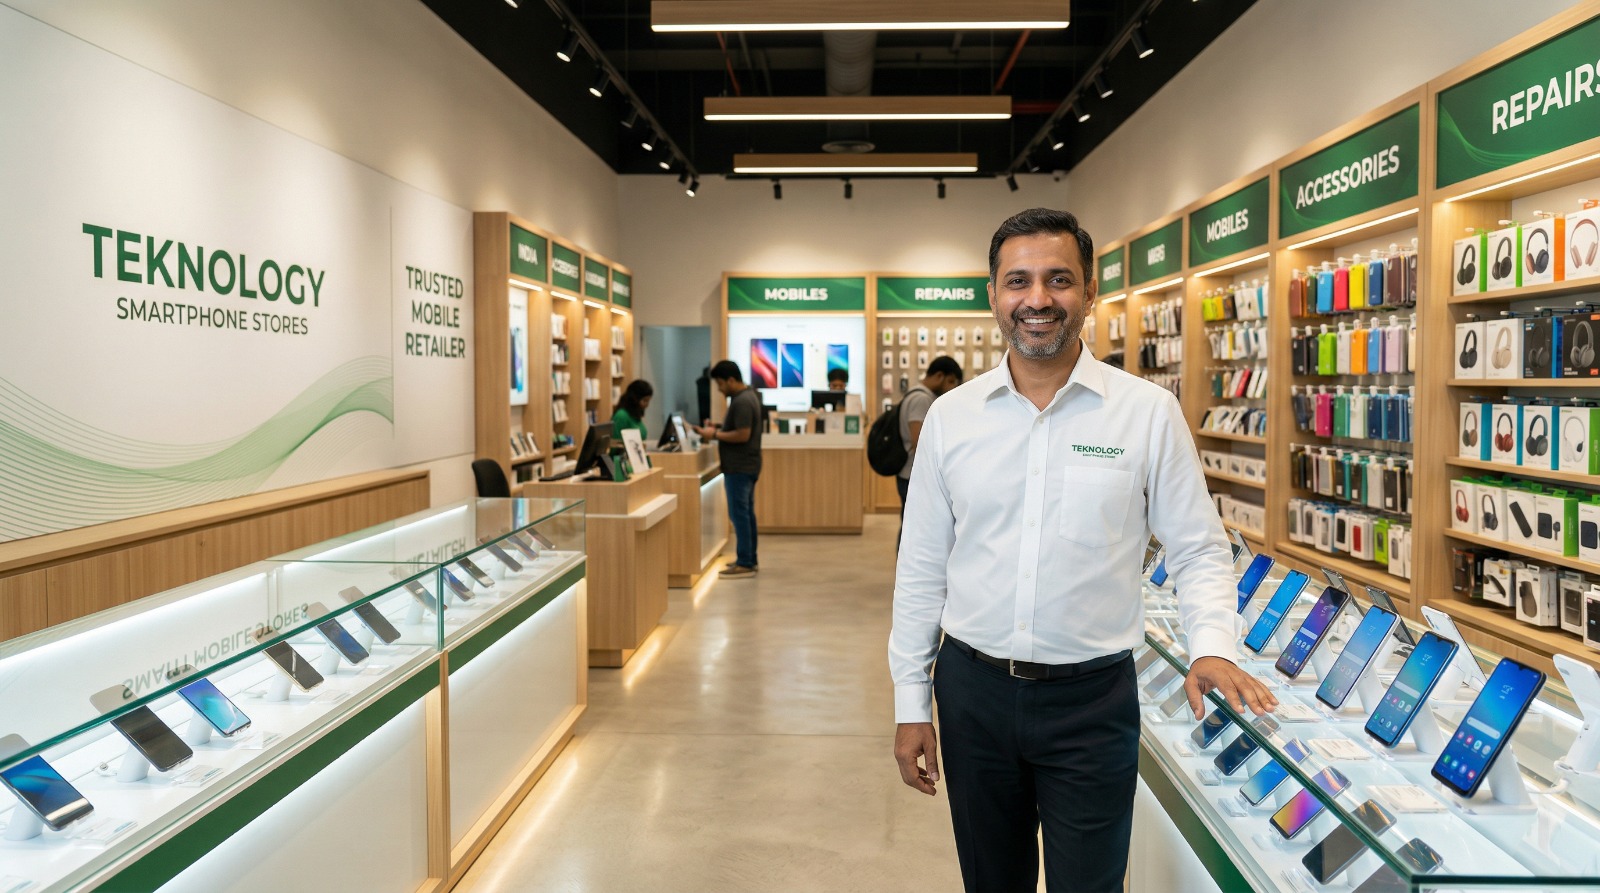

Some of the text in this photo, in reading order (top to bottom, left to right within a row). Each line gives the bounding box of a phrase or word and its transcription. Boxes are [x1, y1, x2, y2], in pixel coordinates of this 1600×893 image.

[1295, 144, 1400, 210] ACCESSORIES
[1206, 208, 1249, 243] MOBILES
[82, 222, 325, 308] TEKNOLOGY
[405, 265, 464, 300] TRUSTED
[764, 287, 828, 301] MOBILES
[915, 287, 975, 301] REPAIRS
[116, 297, 309, 336] SMARTPHONE STORES
[411, 299, 460, 329] MOBILE
[405, 331, 466, 359] RETAILER
[1071, 444, 1125, 456] TEKNOLOGY
